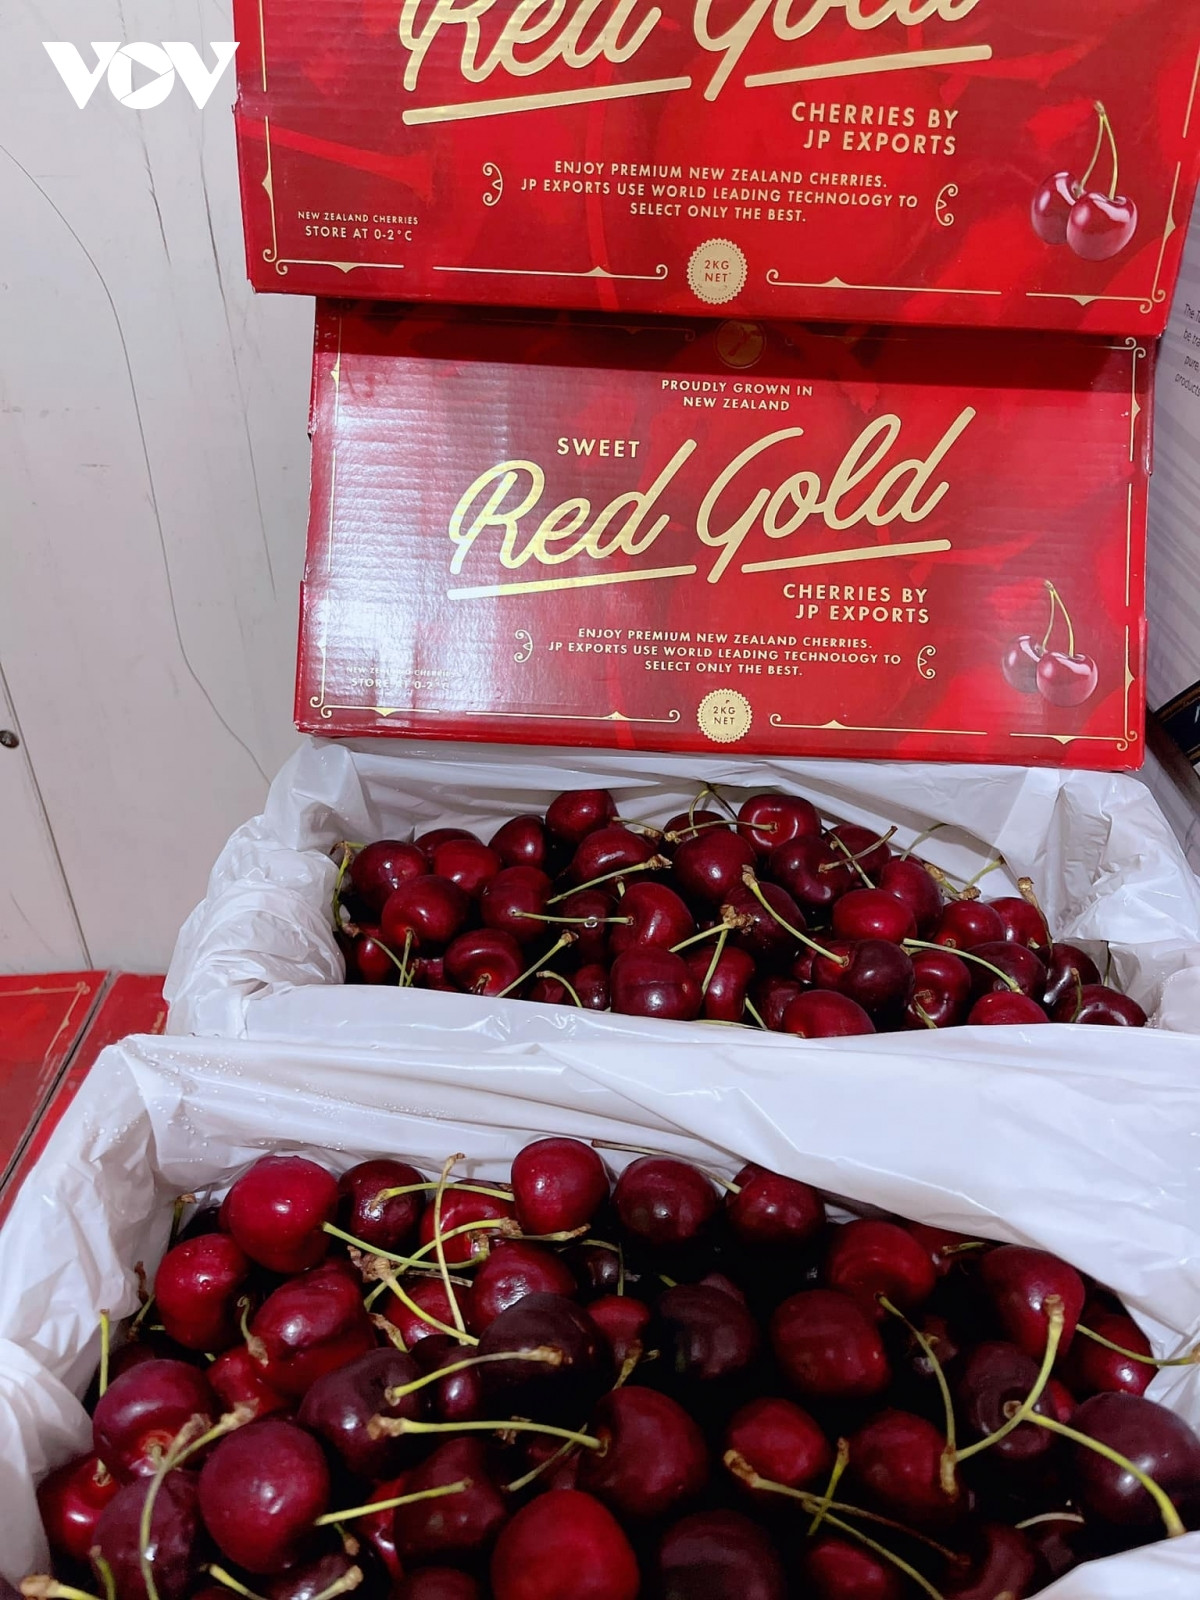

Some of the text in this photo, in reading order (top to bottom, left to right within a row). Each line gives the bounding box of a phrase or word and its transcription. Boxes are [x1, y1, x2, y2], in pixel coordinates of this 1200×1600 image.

[791, 101, 959, 129] CHERRIES BY
[803, 129, 956, 155] JP EXPORTS
[554, 160, 887, 188] ENJOY PREMIUM NEW ZEALAND CHERRIES.
[521, 178, 918, 208] JP EXPORTS USE WORLD LEADING TECHNOLOGY TO
[298, 211, 418, 225] NEW ZEALAND CHERRIES
[630, 202, 806, 222] SELECT ONLY THE BEST.
[305, 225, 347, 238] STORE
[353, 228, 368, 239] AT
[704, 260, 729, 270] 2KG
[705, 273, 728, 283] NET
[661, 379, 813, 396] PROUDLY GROWN IN
[683, 396, 790, 411] NEW ZEALAND
[557, 437, 640, 458] SWEET
[448, 406, 977, 584] Red Gold
[783, 584, 928, 603] CHERRIES BY
[795, 604, 929, 624] JP EXPORTS
[578, 628, 873, 649] ENJOY PREMIUM NEW ZEALAND CHERRIES.
[549, 641, 901, 665] JP EXPORTS USE WORLD LEADING TECHNOLOGY TO
[645, 660, 803, 676] SELECT ONLY THE BEST.
[351, 678, 389, 688] STORE
[713, 705, 736, 715] 2KG
[714, 717, 735, 725] NET
